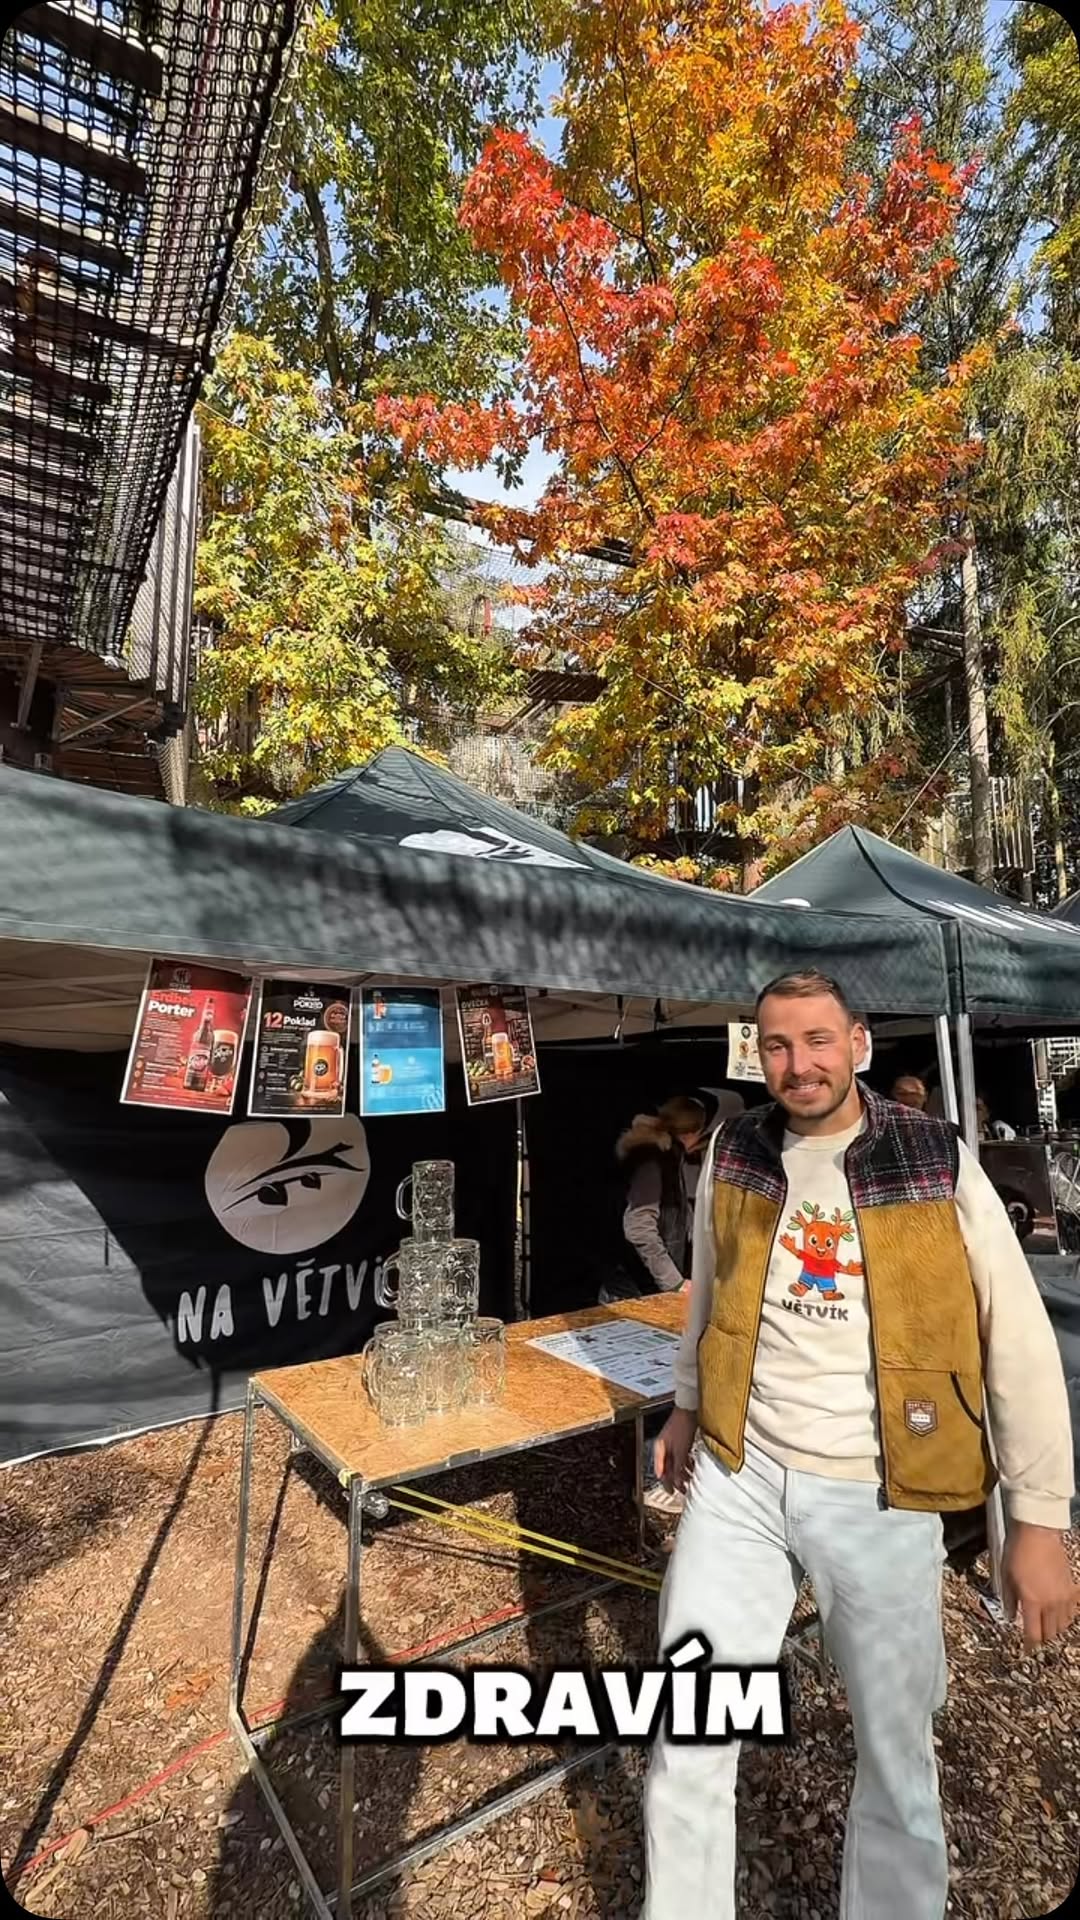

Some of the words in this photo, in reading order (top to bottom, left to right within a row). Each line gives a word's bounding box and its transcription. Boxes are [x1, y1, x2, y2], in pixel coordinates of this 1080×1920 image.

[148, 1000, 196, 1018] Porter
[264, 1012, 283, 1029] 12
[283, 1016, 317, 1027] Poklad
[178, 1273, 234, 1343] NA
